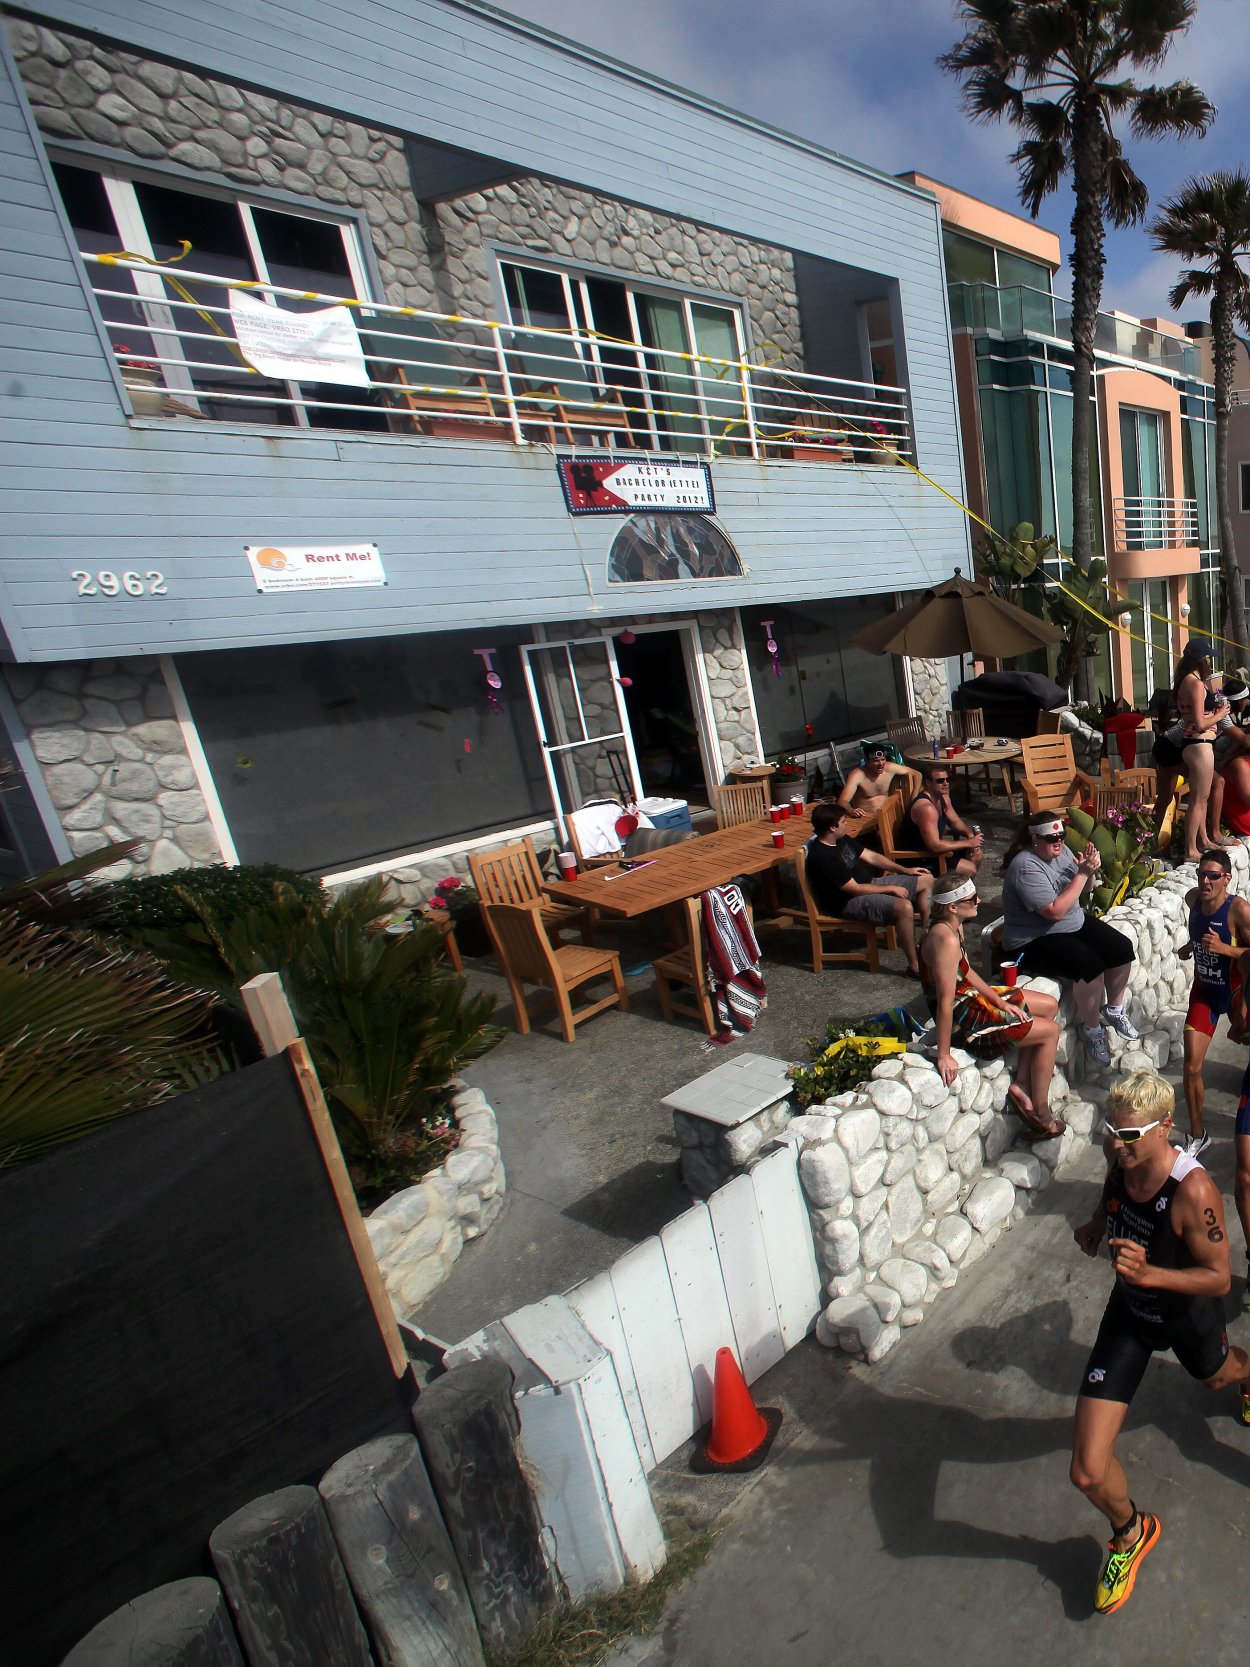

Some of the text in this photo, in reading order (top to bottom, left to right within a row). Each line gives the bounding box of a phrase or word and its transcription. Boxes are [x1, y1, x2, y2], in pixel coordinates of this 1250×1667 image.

[634, 493, 704, 504] PARTY 2012!
[304, 551, 372, 563] Rent Me!
[70, 570, 169, 597] 2962
[1195, 952, 1219, 967] ESP
[1197, 964, 1222, 978] BH
[1203, 1207, 1225, 1244] 36
